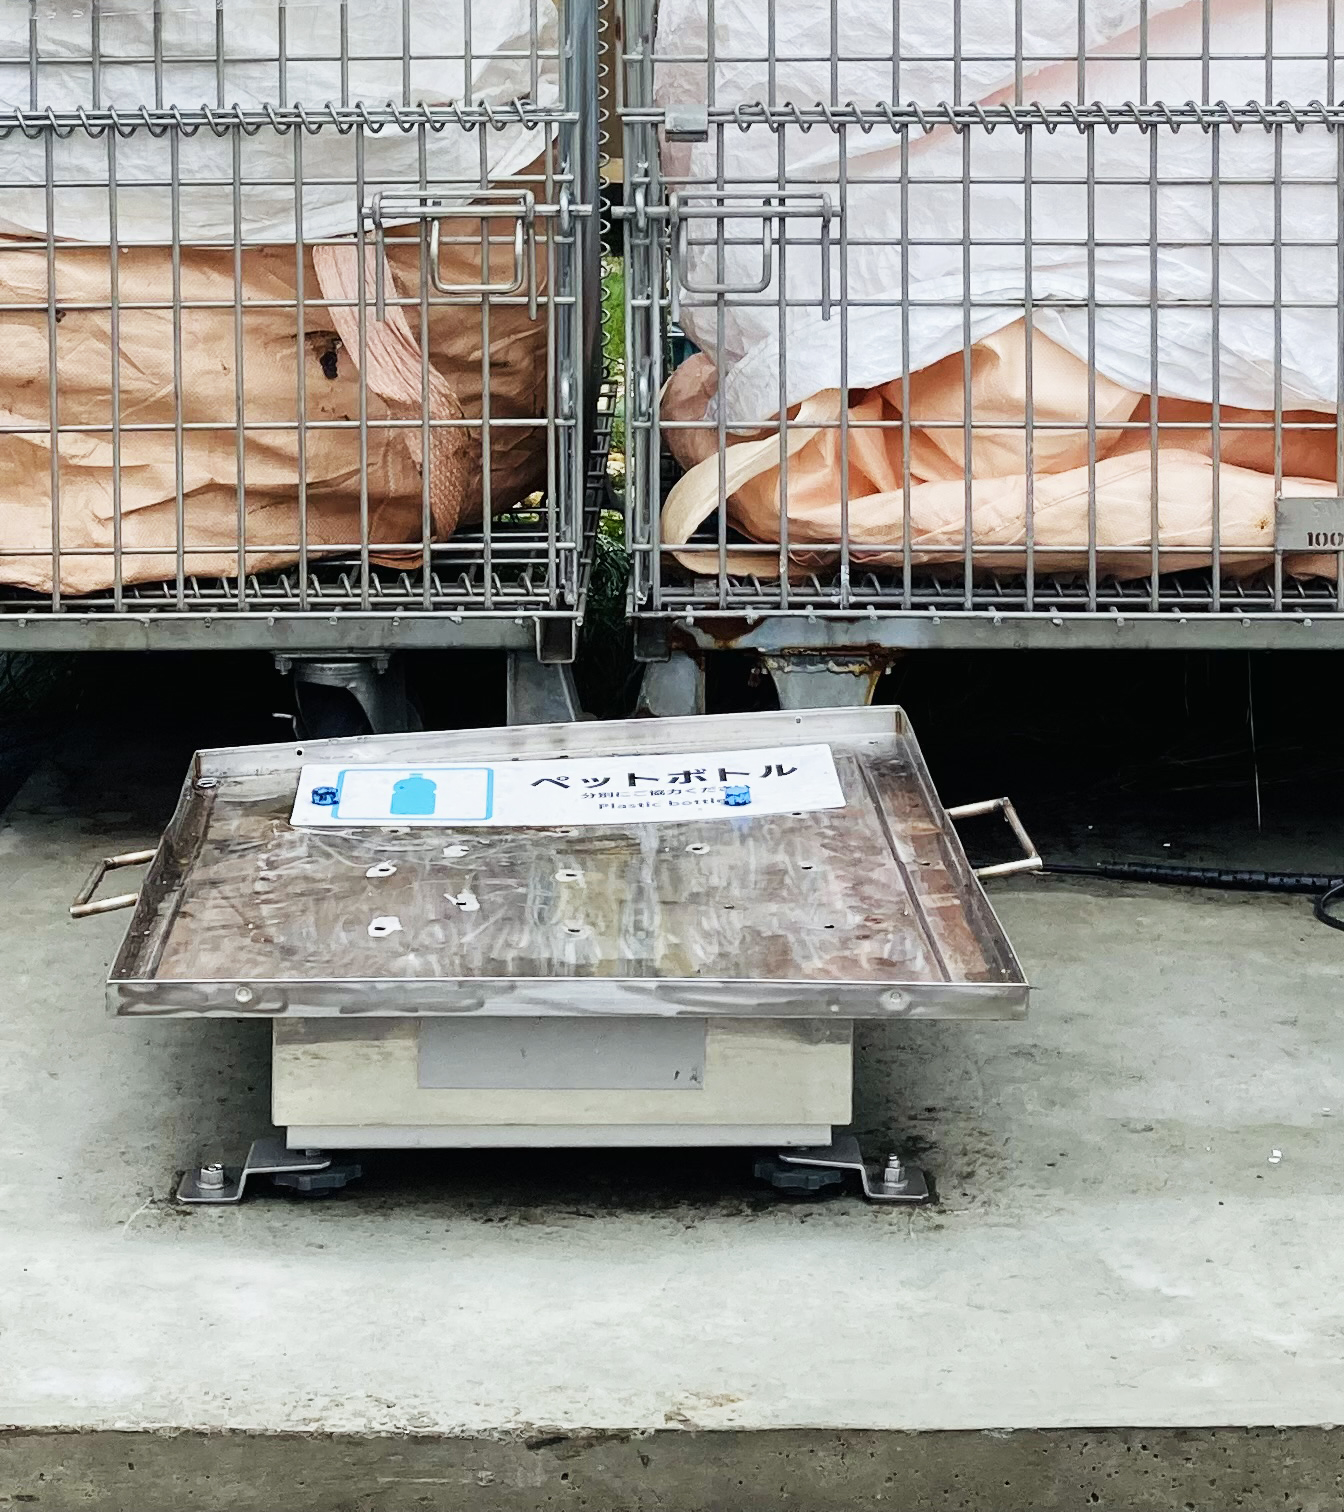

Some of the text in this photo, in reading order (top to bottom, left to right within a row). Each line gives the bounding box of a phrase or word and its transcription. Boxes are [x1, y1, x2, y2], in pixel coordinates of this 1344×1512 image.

[531, 762, 798, 789] ペットボトル
[668, 799, 726, 808] bottle
